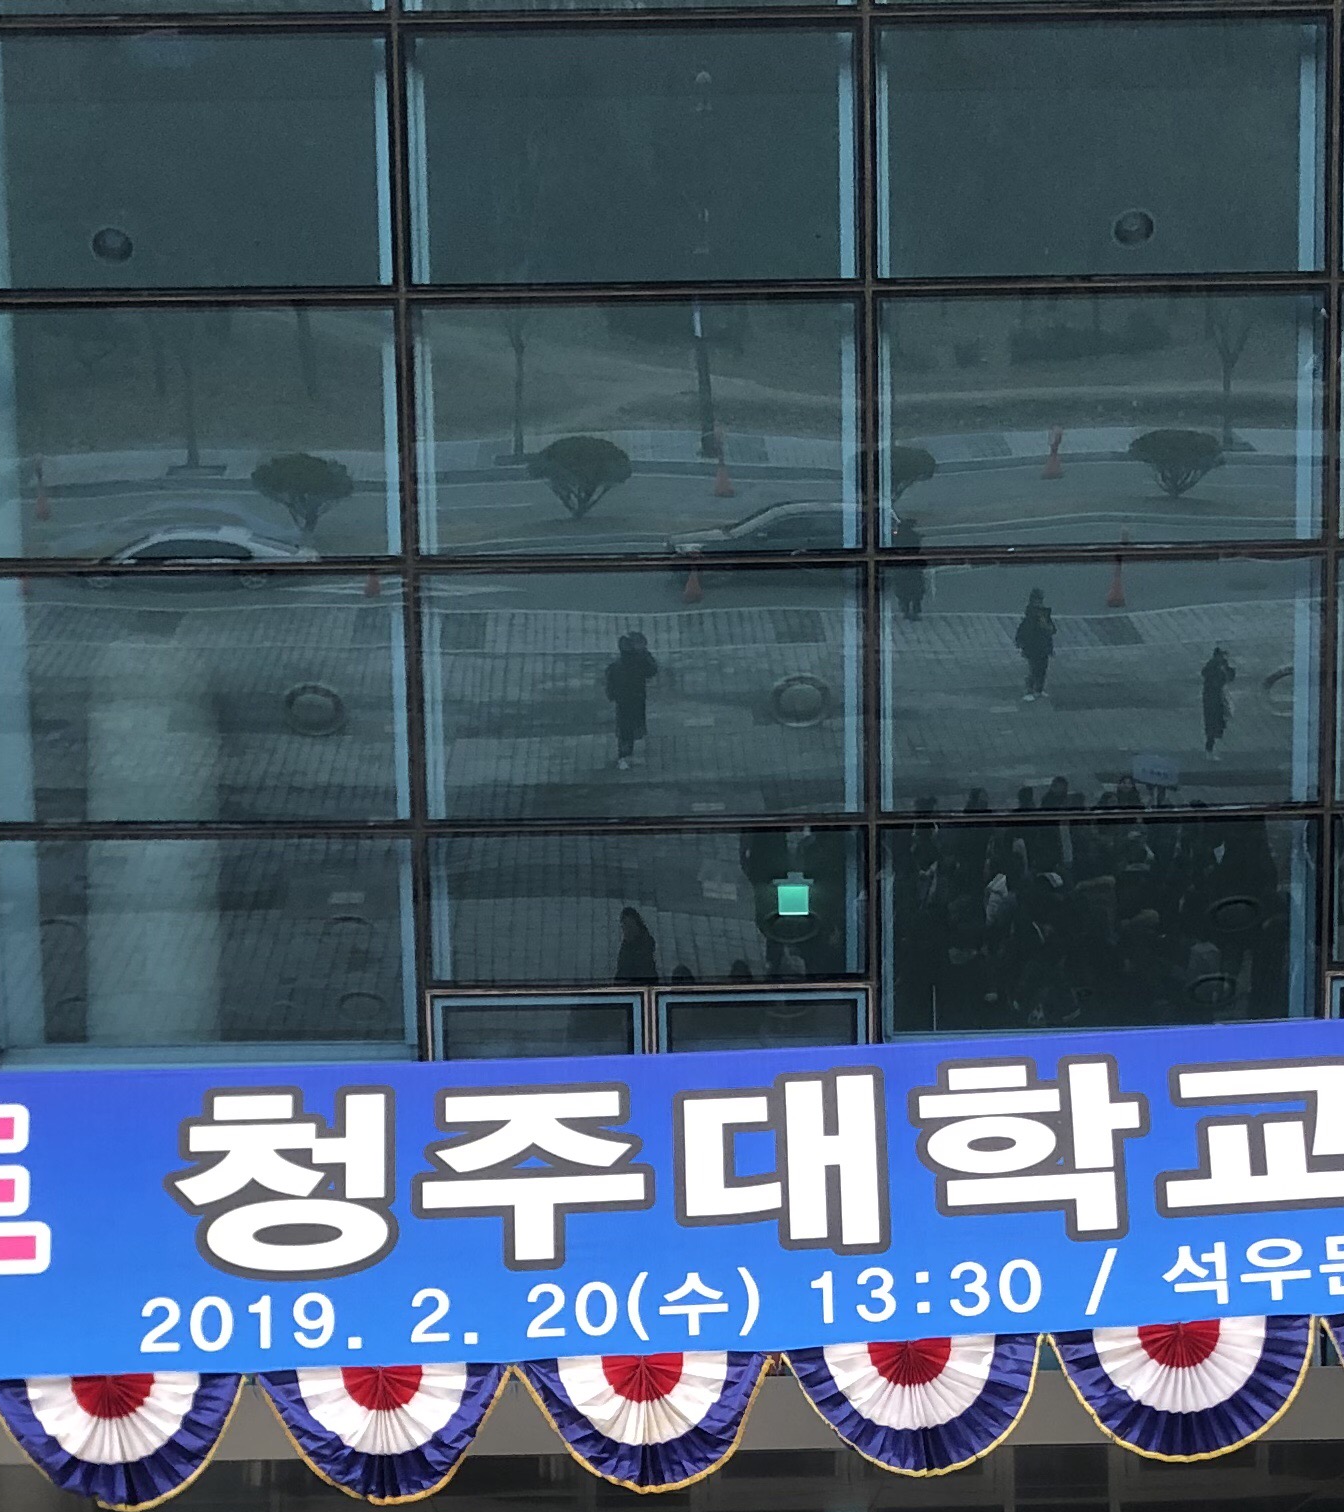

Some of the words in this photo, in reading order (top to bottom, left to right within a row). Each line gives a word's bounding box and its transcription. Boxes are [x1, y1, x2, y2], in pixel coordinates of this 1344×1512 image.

[140, 1292, 362, 1353] 2019.
[410, 1287, 479, 1345] 2.
[526, 1266, 761, 1341] 20(수)
[810, 1258, 1043, 1324] 13:30
